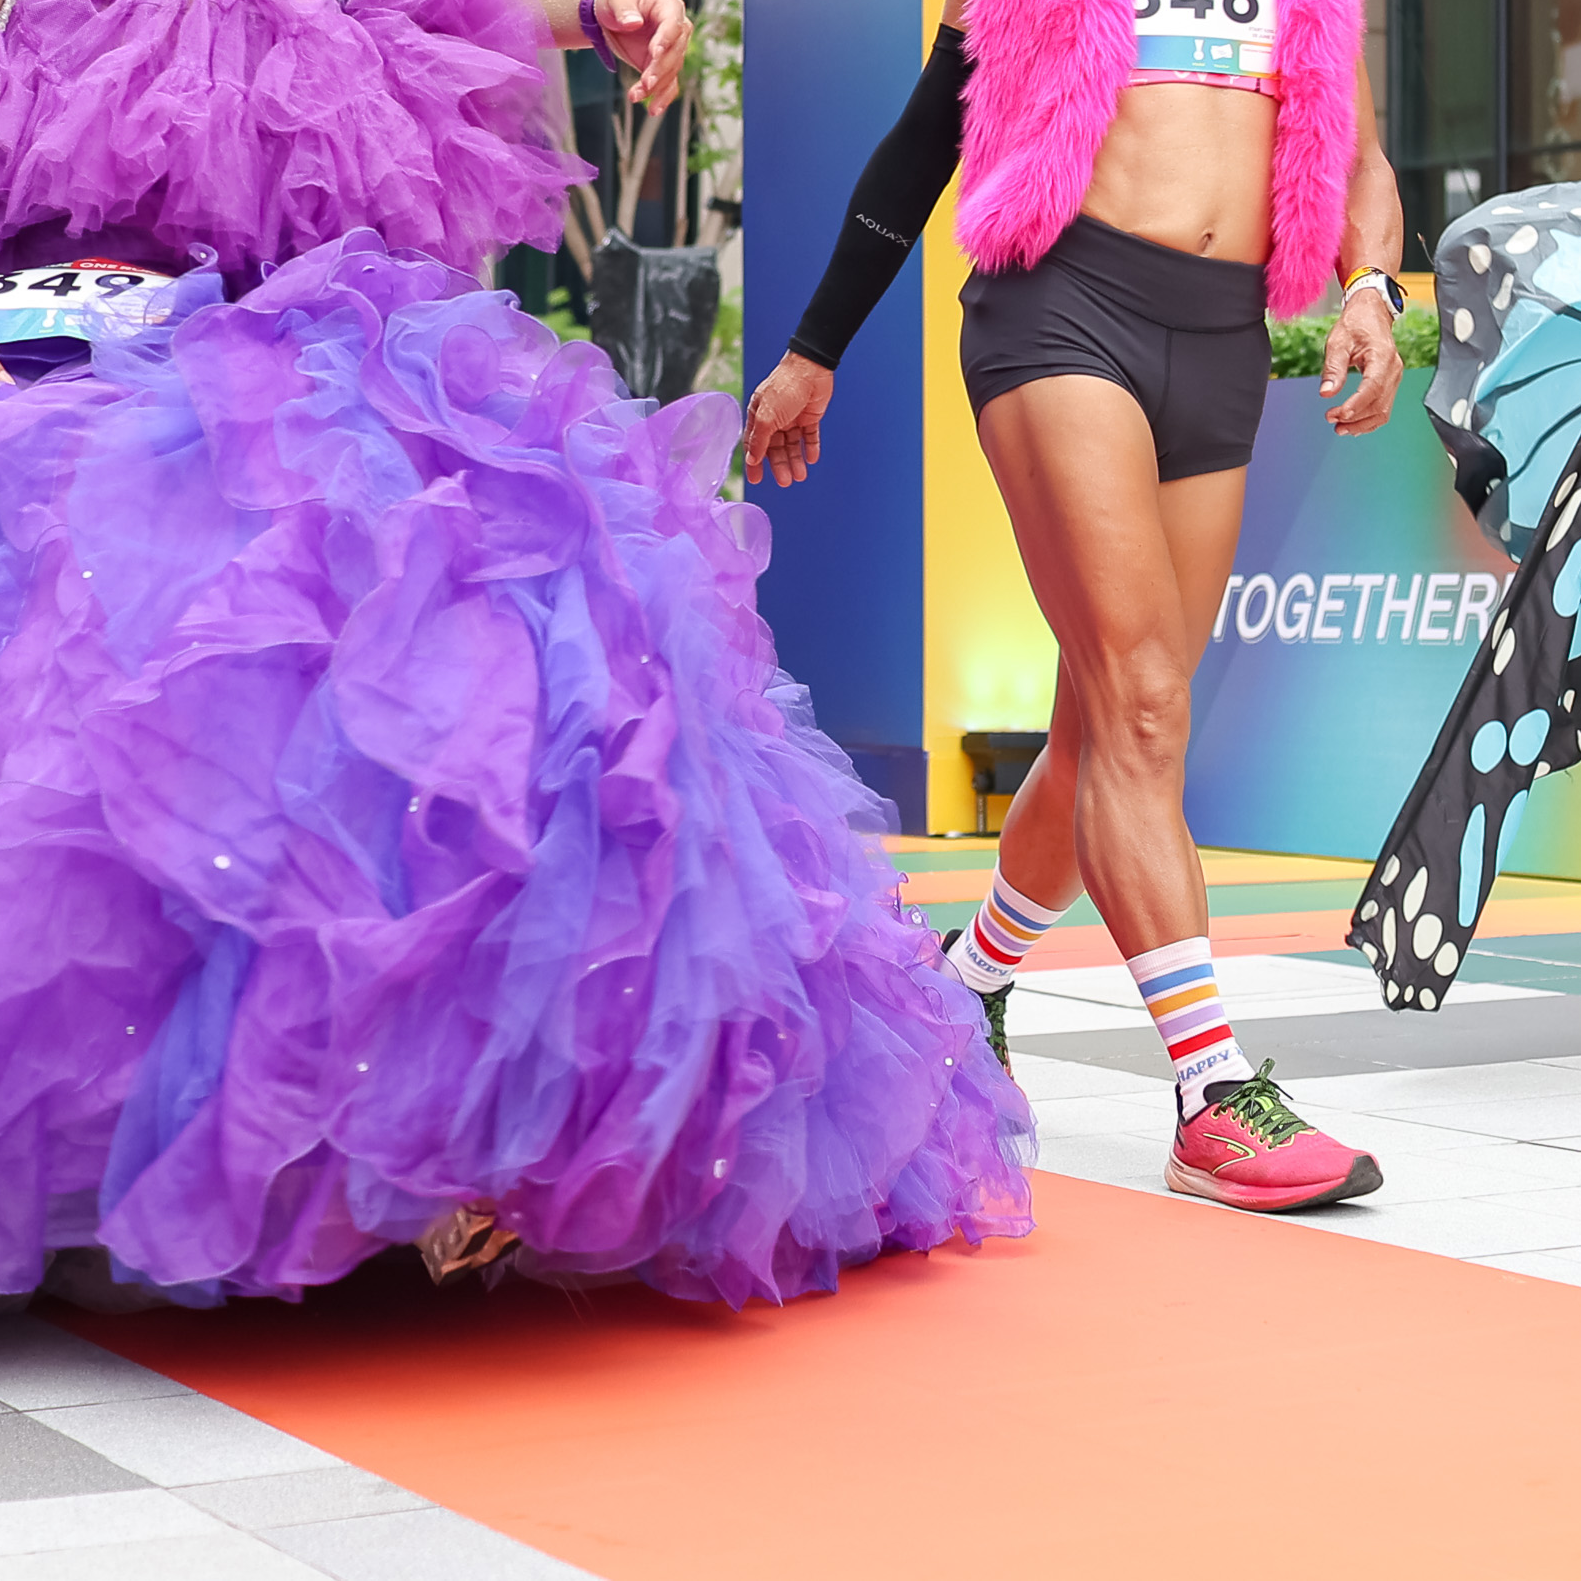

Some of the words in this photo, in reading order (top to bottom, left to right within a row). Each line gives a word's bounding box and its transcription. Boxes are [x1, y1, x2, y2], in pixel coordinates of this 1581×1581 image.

[1211, 572, 1517, 646] TOGETHER
[965, 942, 1009, 976] HAPPY
[1176, 1048, 1230, 1083] HAPPY
